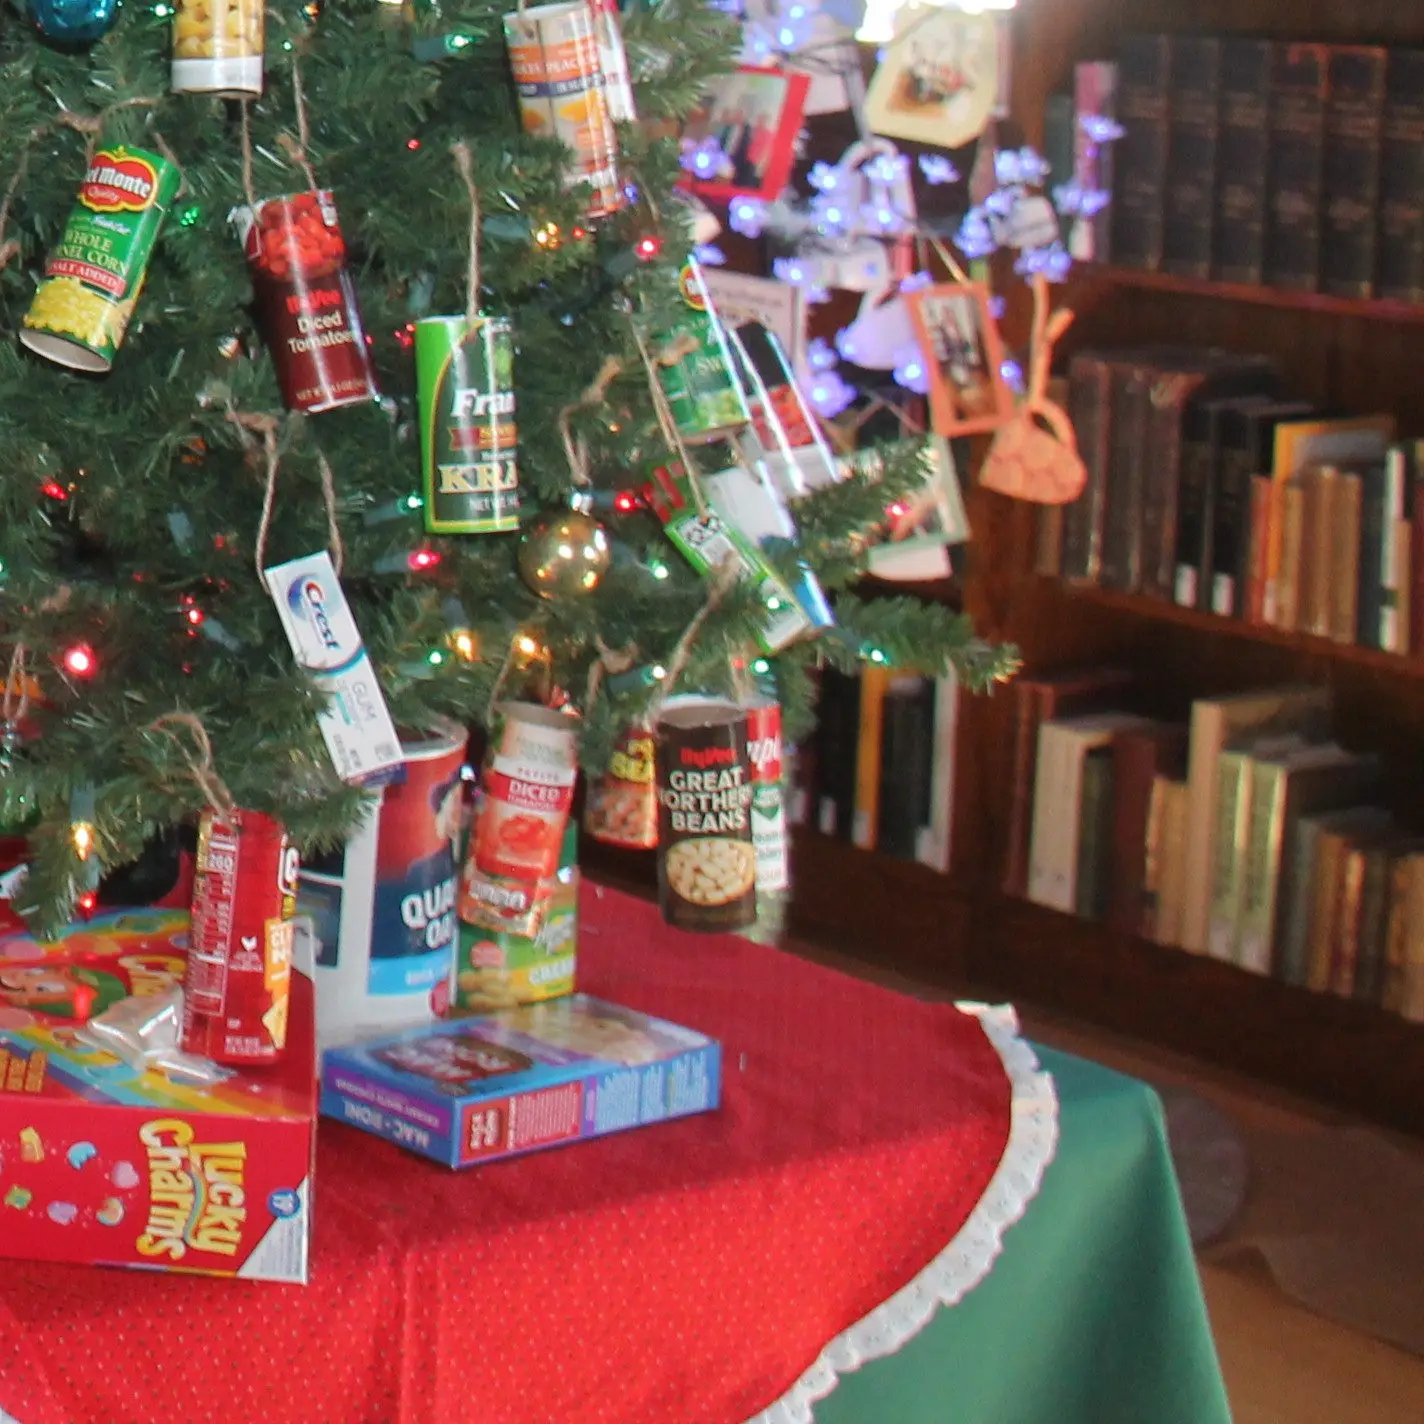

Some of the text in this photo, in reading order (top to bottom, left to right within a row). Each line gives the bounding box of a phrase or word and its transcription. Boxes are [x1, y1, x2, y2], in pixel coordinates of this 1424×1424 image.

[99, 166, 152, 199] Monte
[297, 311, 343, 334] Diced
[304, 579, 343, 653] Crest
[508, 779, 560, 802] DICED
[669, 765, 745, 792] GREAT
[670, 809, 747, 834] BEANS
[135, 1117, 195, 1261] Charms
[185, 1141, 248, 1258] Lucky
